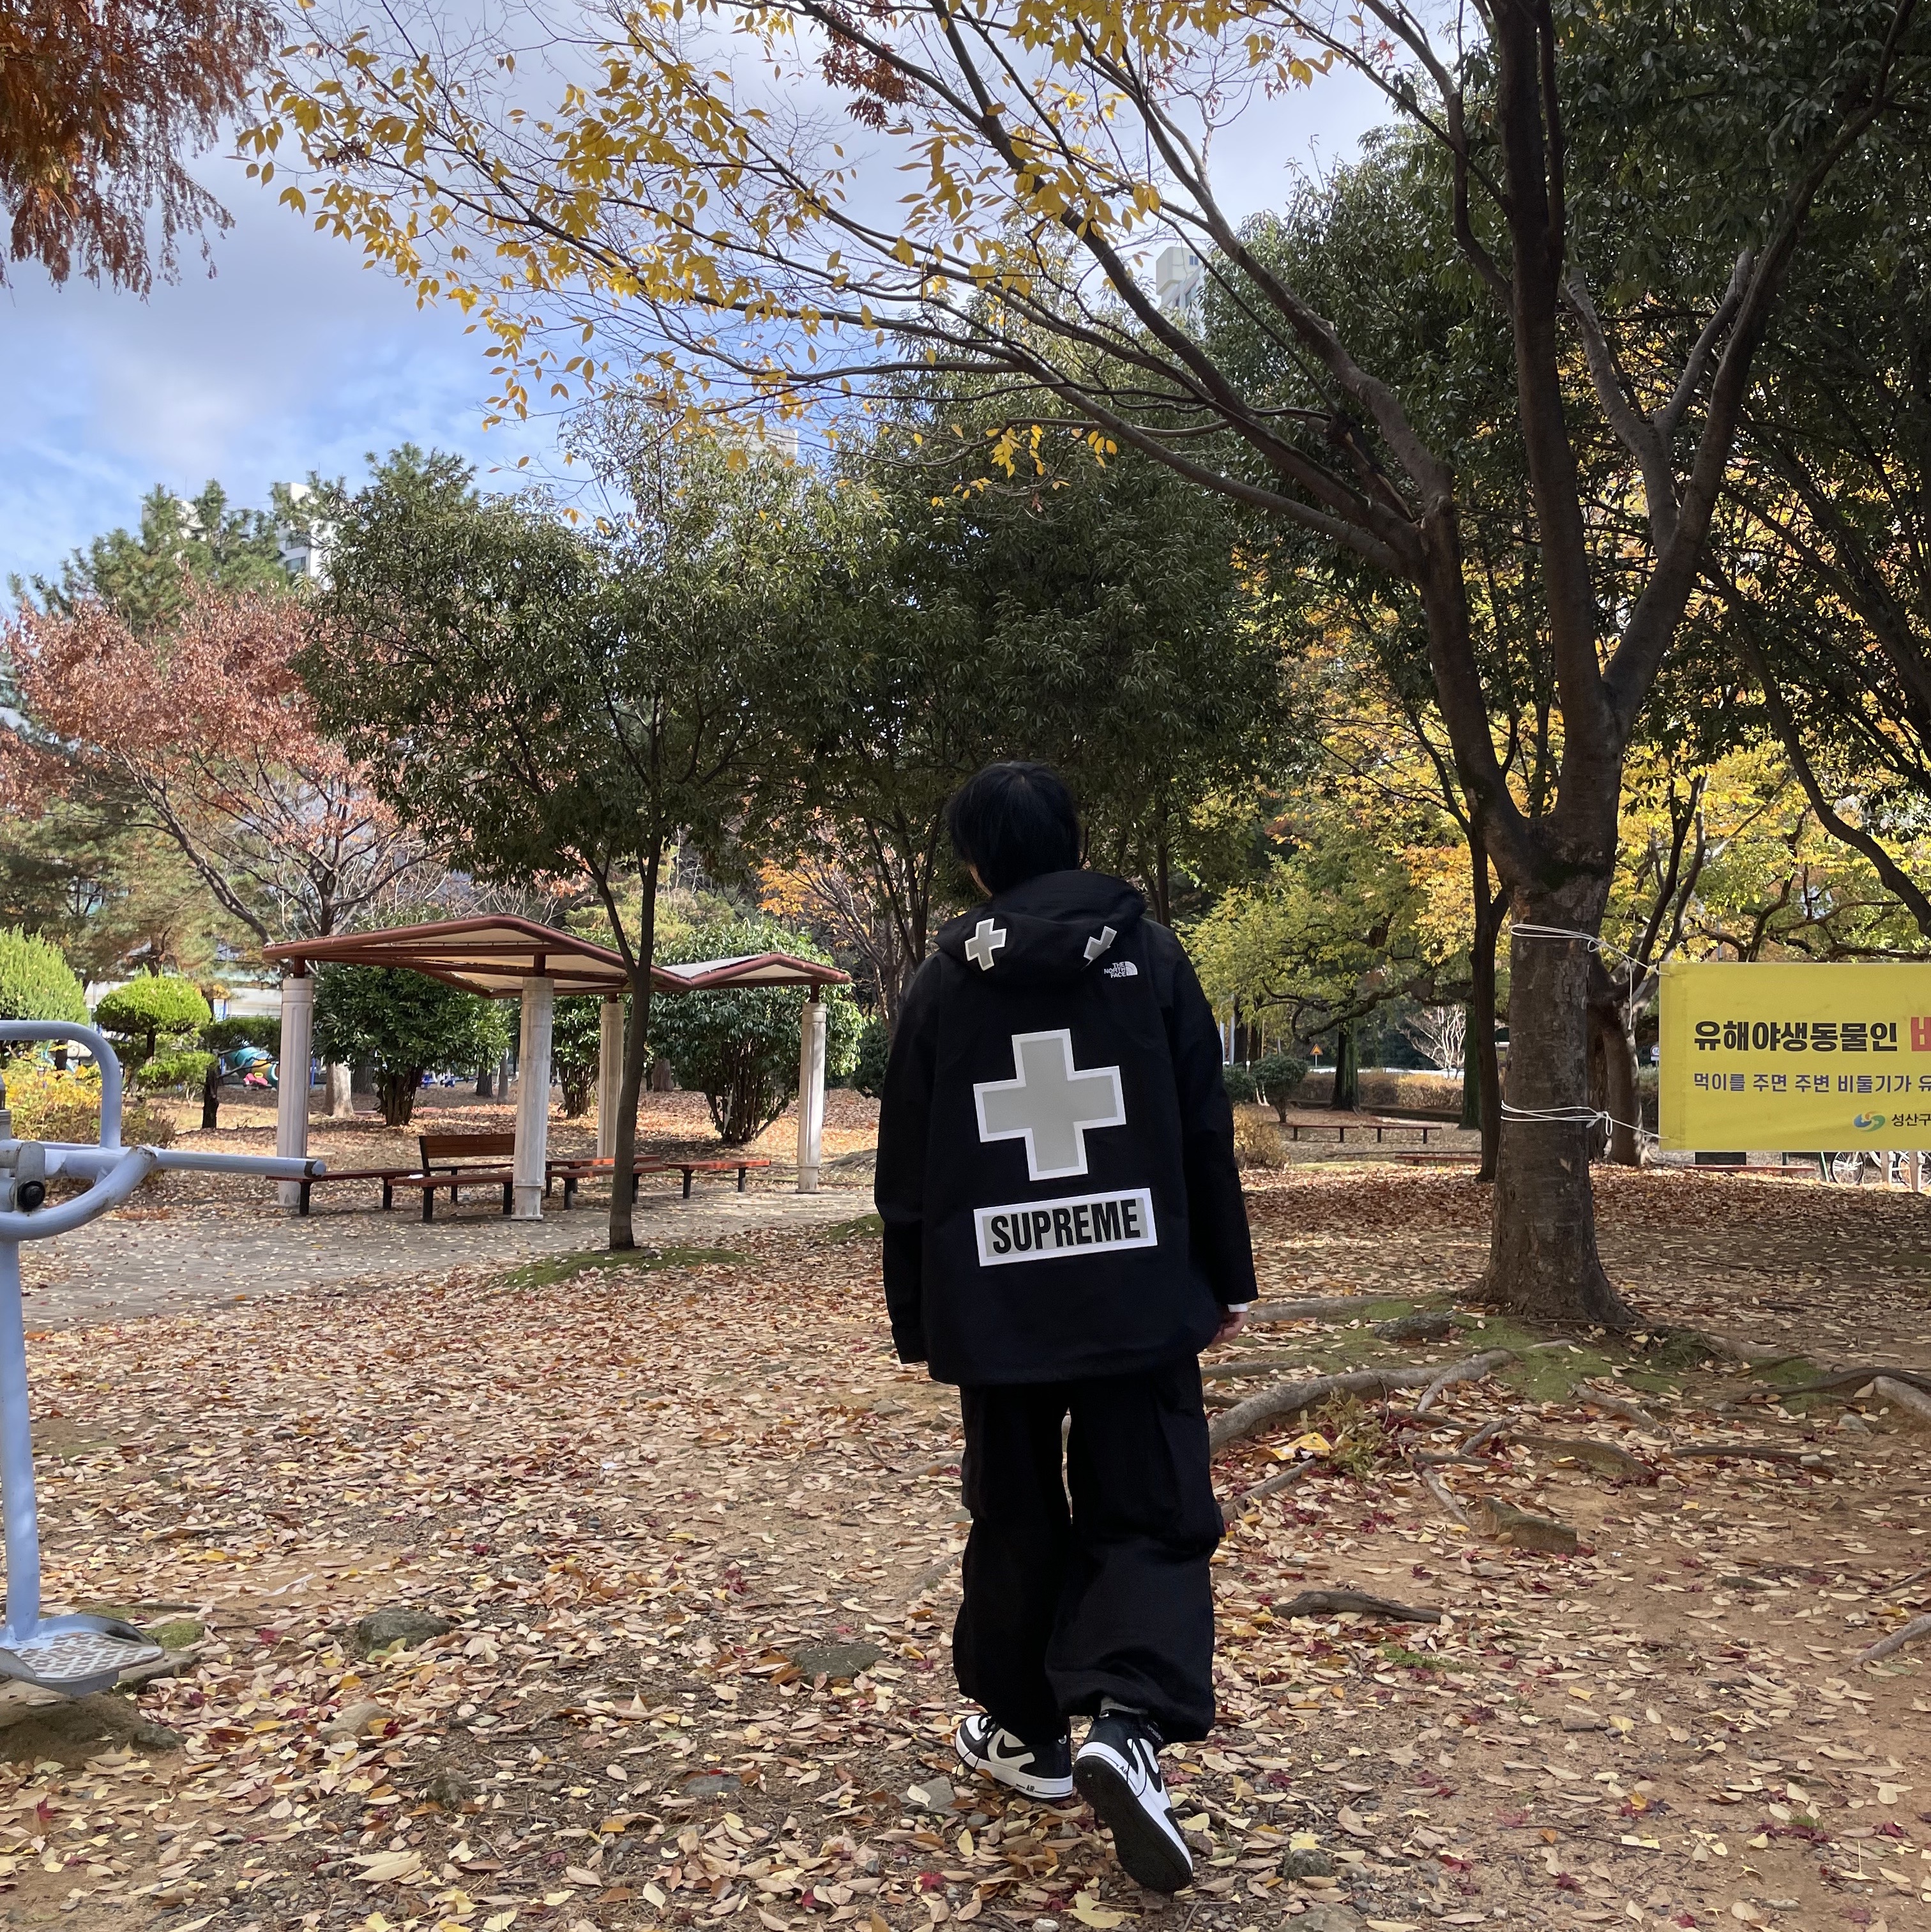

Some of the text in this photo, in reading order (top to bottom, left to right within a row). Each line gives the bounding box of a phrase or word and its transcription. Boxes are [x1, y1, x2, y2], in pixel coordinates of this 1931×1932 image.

[1693, 1020, 1898, 1052] 유해야생동물인
[1693, 1073, 1745, 1092] 먹이를
[1752, 1074, 1787, 1092] 주면
[1794, 1075, 1830, 1093] 주변
[1837, 1075, 1912, 1093] 비둘기가
[1891, 1113, 1931, 1127] 성산구
[990, 1198, 1141, 1254] SUPREME
[1026, 1784, 1035, 1793] AIR
